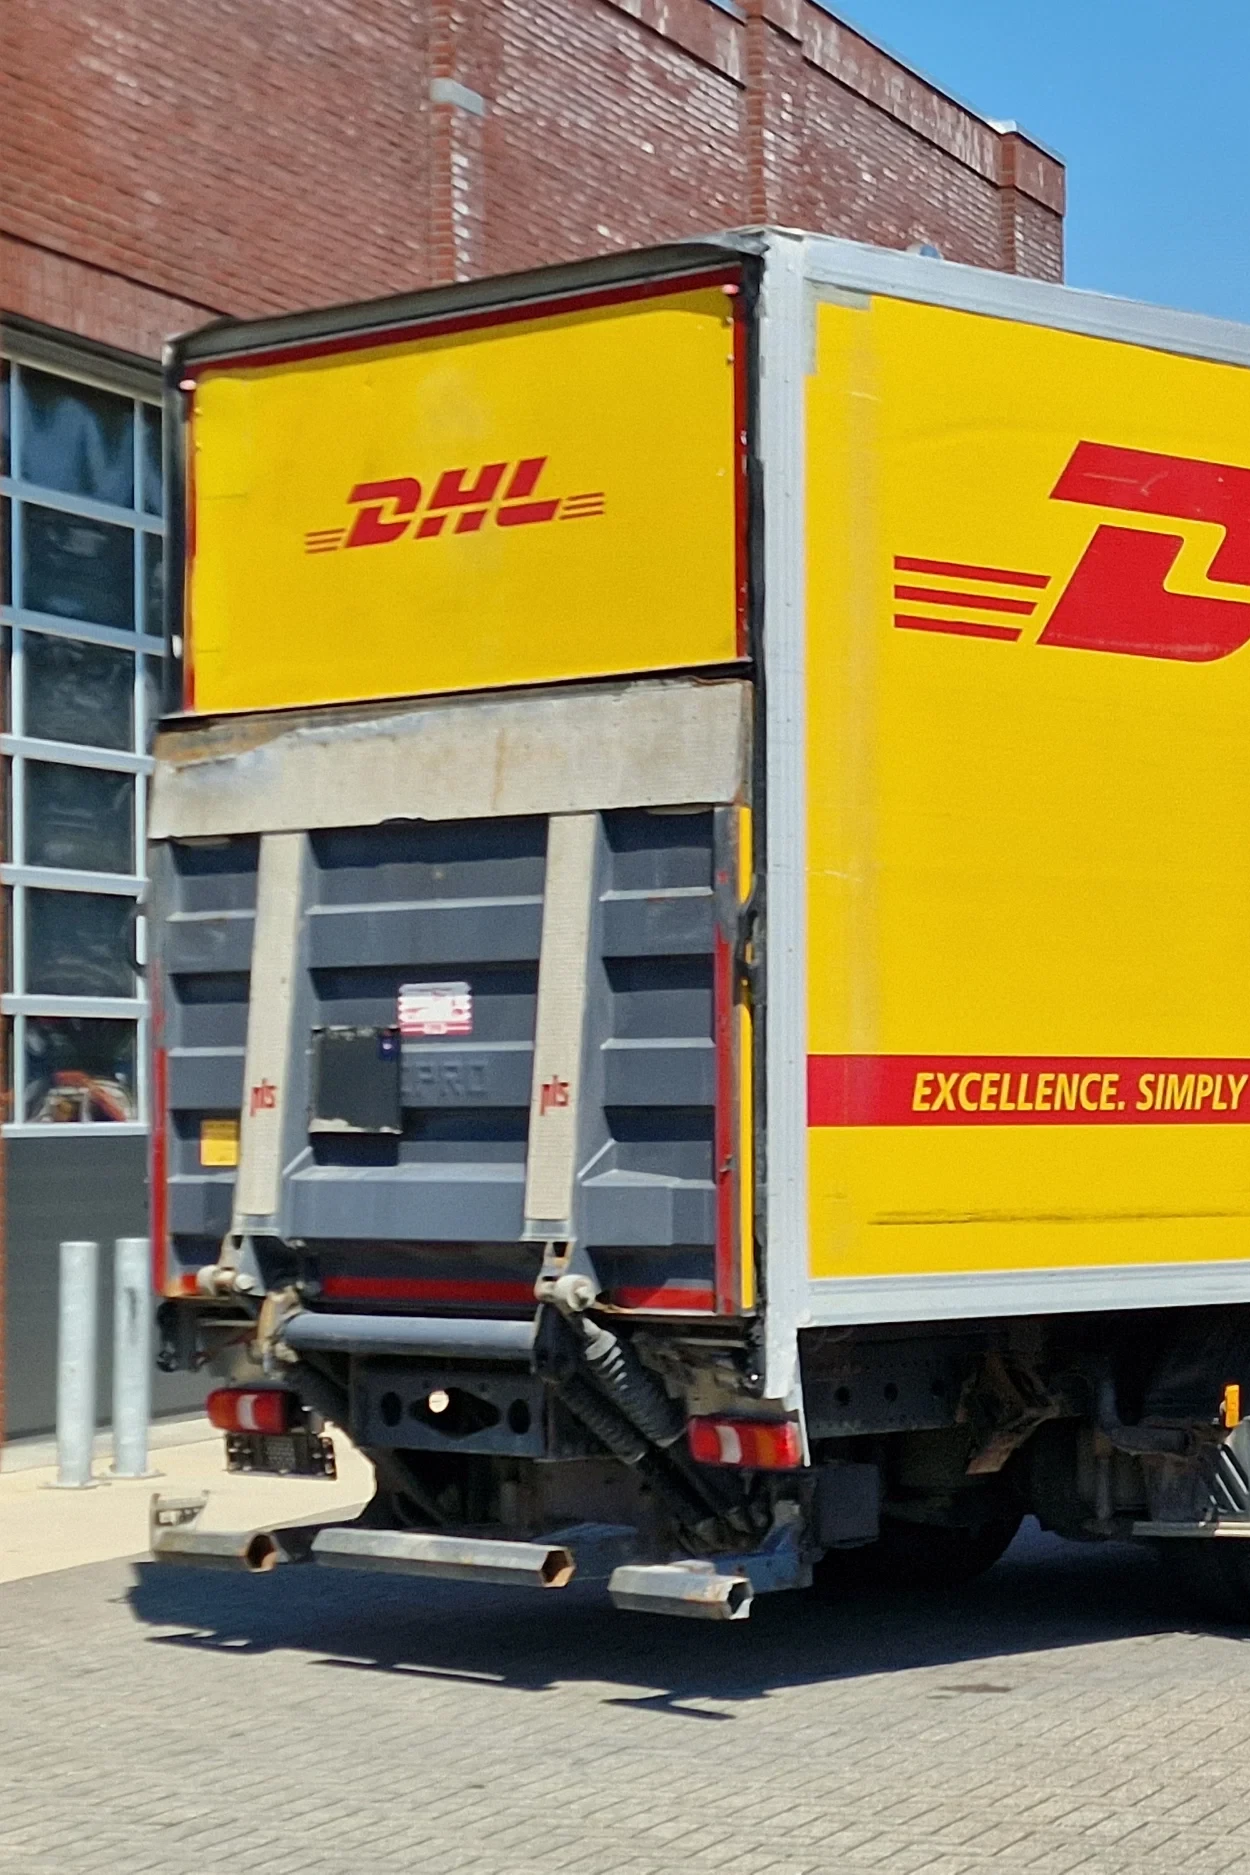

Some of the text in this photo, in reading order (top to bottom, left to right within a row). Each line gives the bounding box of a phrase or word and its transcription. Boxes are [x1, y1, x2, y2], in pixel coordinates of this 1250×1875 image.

[344, 455, 560, 549] DHL
[911, 1071, 1126, 1112] EXCELLENCE.
[1135, 1073, 1249, 1112] SIMPLY
